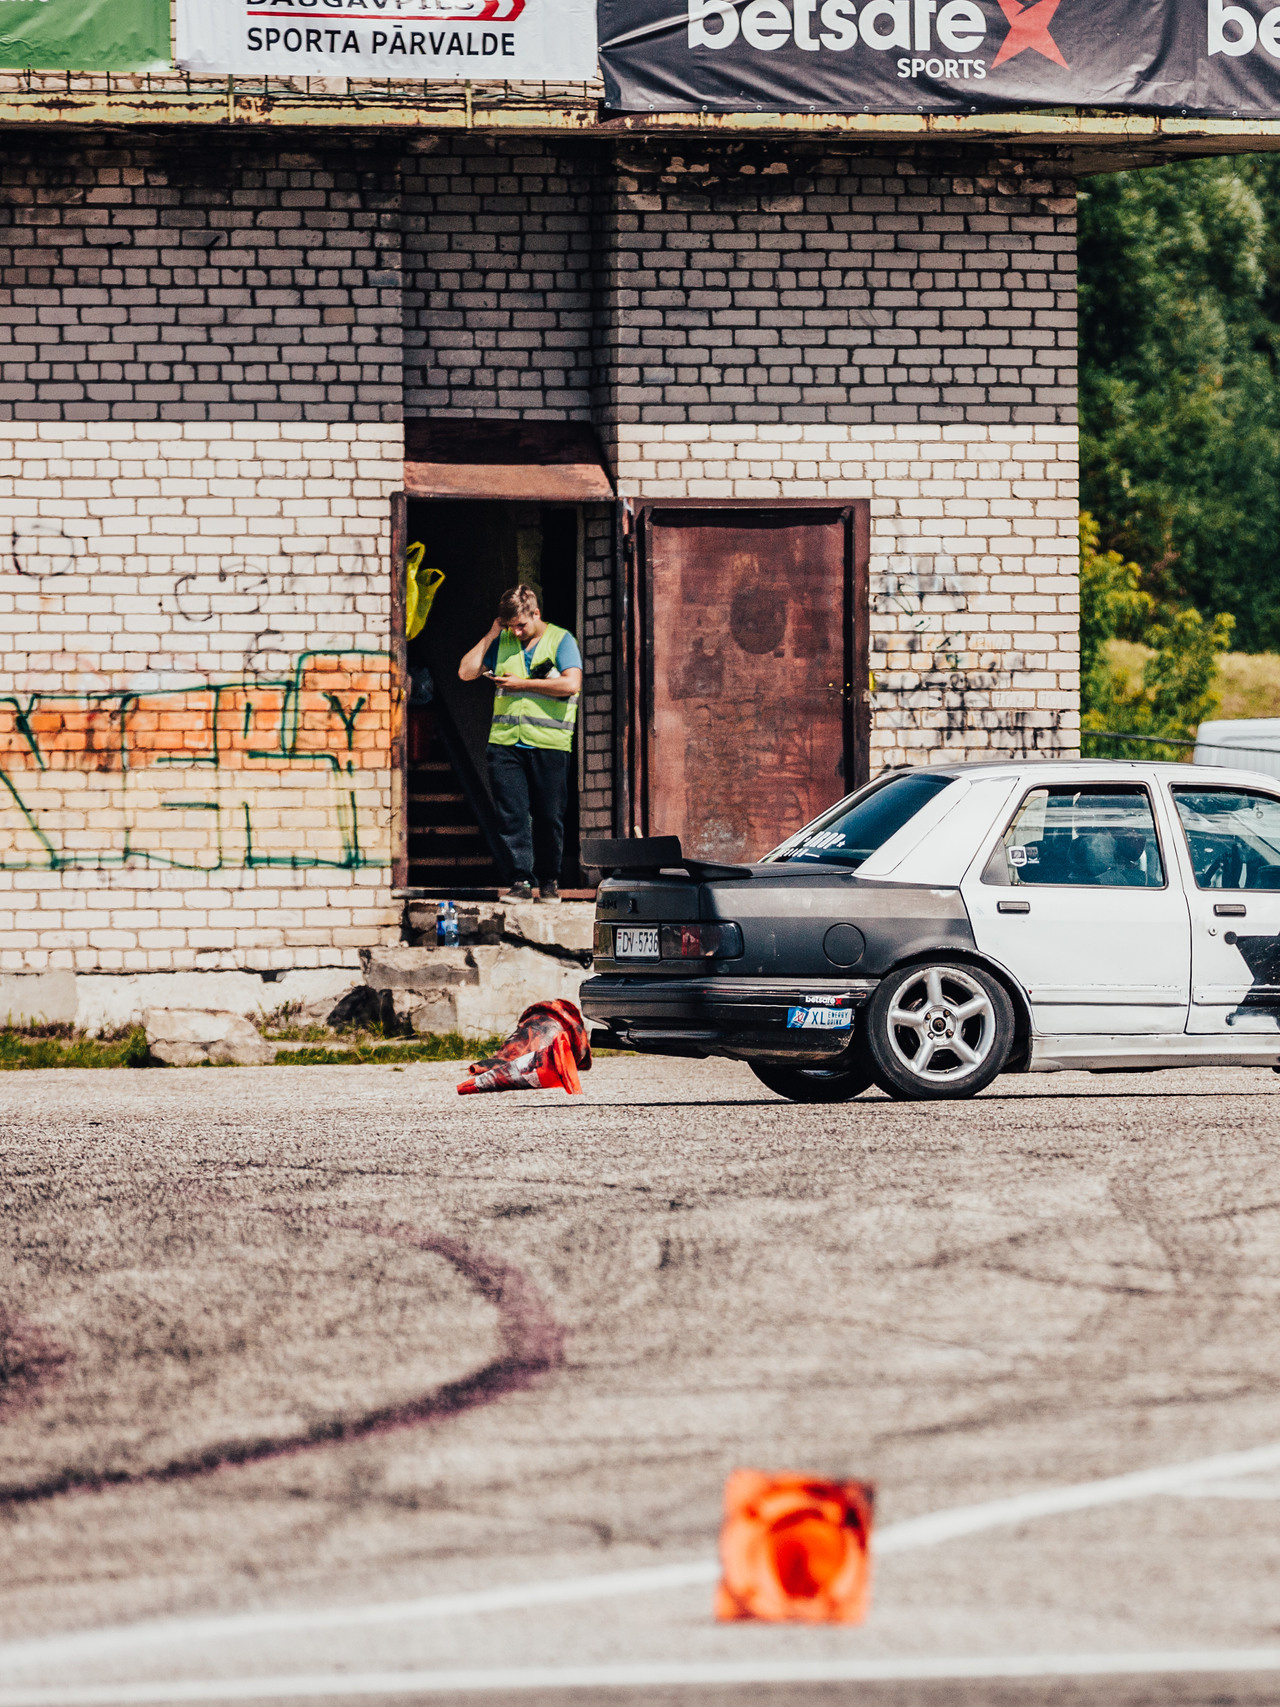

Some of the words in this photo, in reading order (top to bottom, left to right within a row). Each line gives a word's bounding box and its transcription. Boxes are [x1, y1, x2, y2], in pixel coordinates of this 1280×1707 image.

[688, 0, 987, 53] betsafe
[247, 27, 360, 53] SPORTA
[372, 25, 515, 56] PĀRVALDE
[897, 58, 987, 79] SPORTS
[805, 995, 836, 1005] betsafe
[811, 1011, 826, 1025] XL
